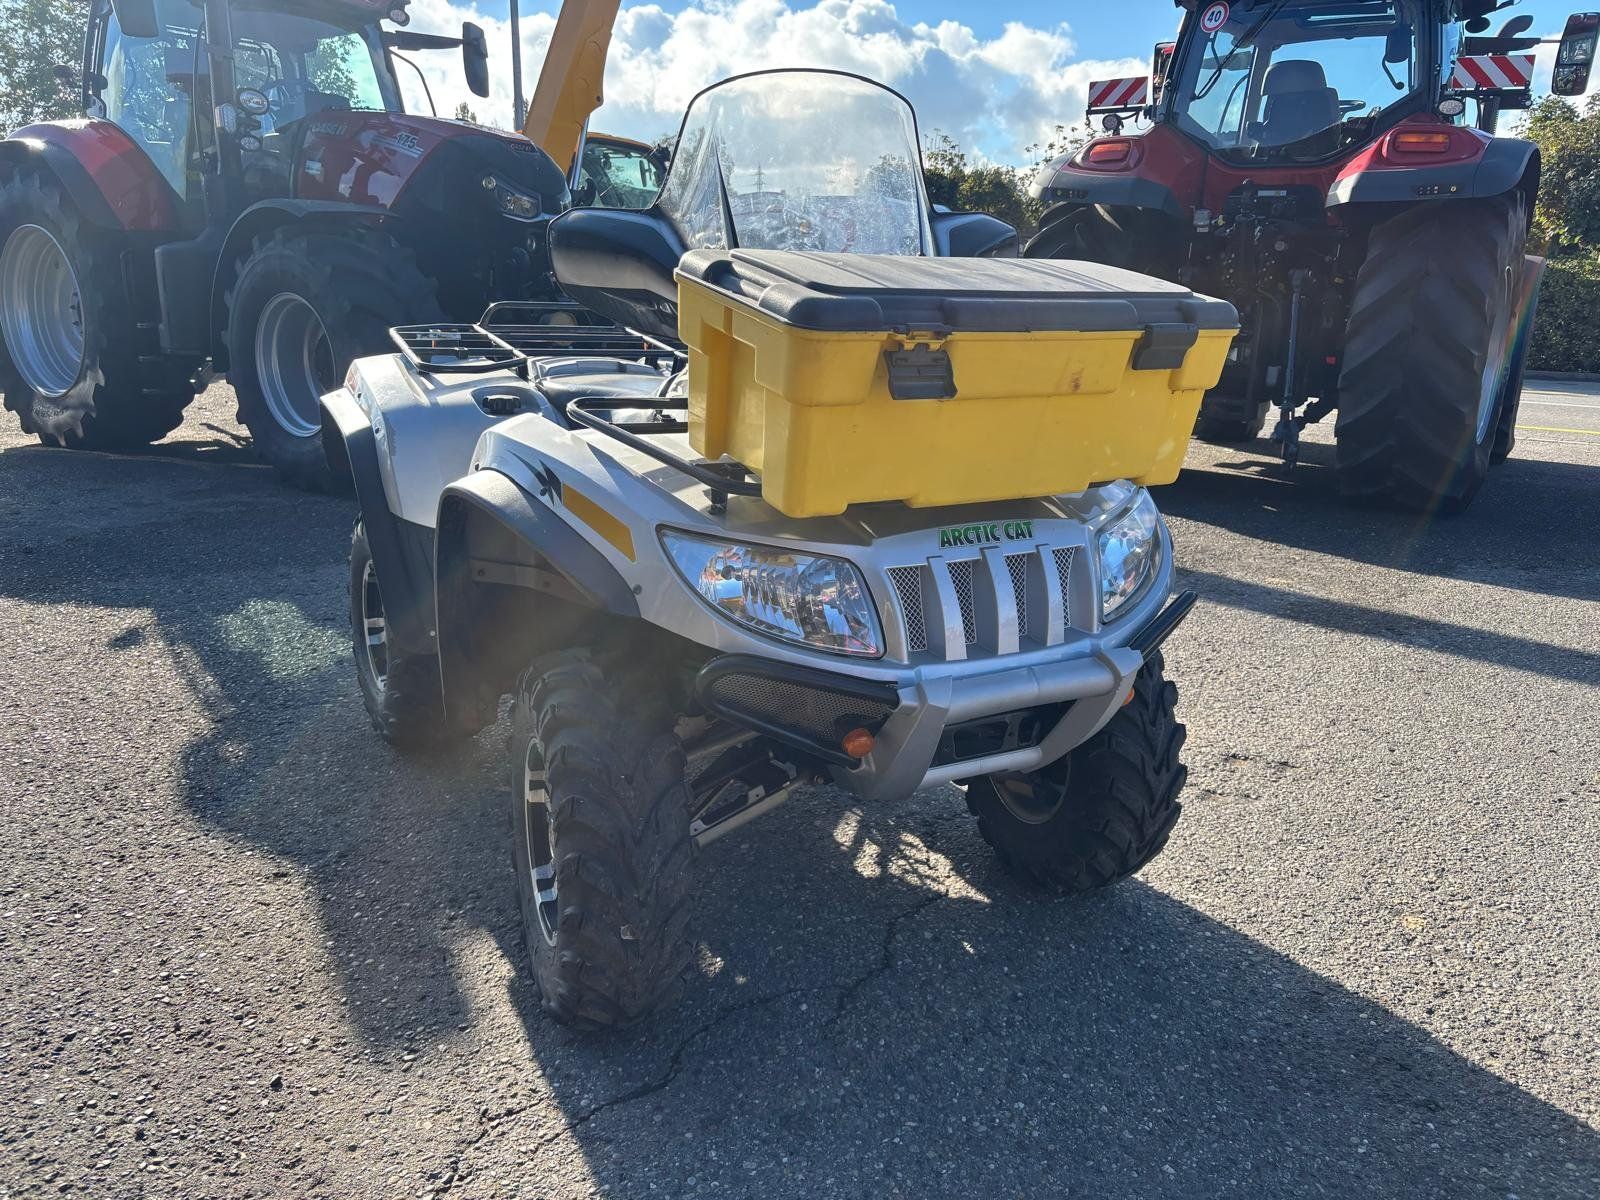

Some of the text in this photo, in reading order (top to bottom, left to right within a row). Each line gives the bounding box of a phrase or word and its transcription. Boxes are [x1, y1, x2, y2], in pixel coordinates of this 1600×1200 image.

[1207, 10, 1222, 23] 40
[395, 131, 418, 149] 175
[939, 520, 1034, 548] ARCTIC CAT
